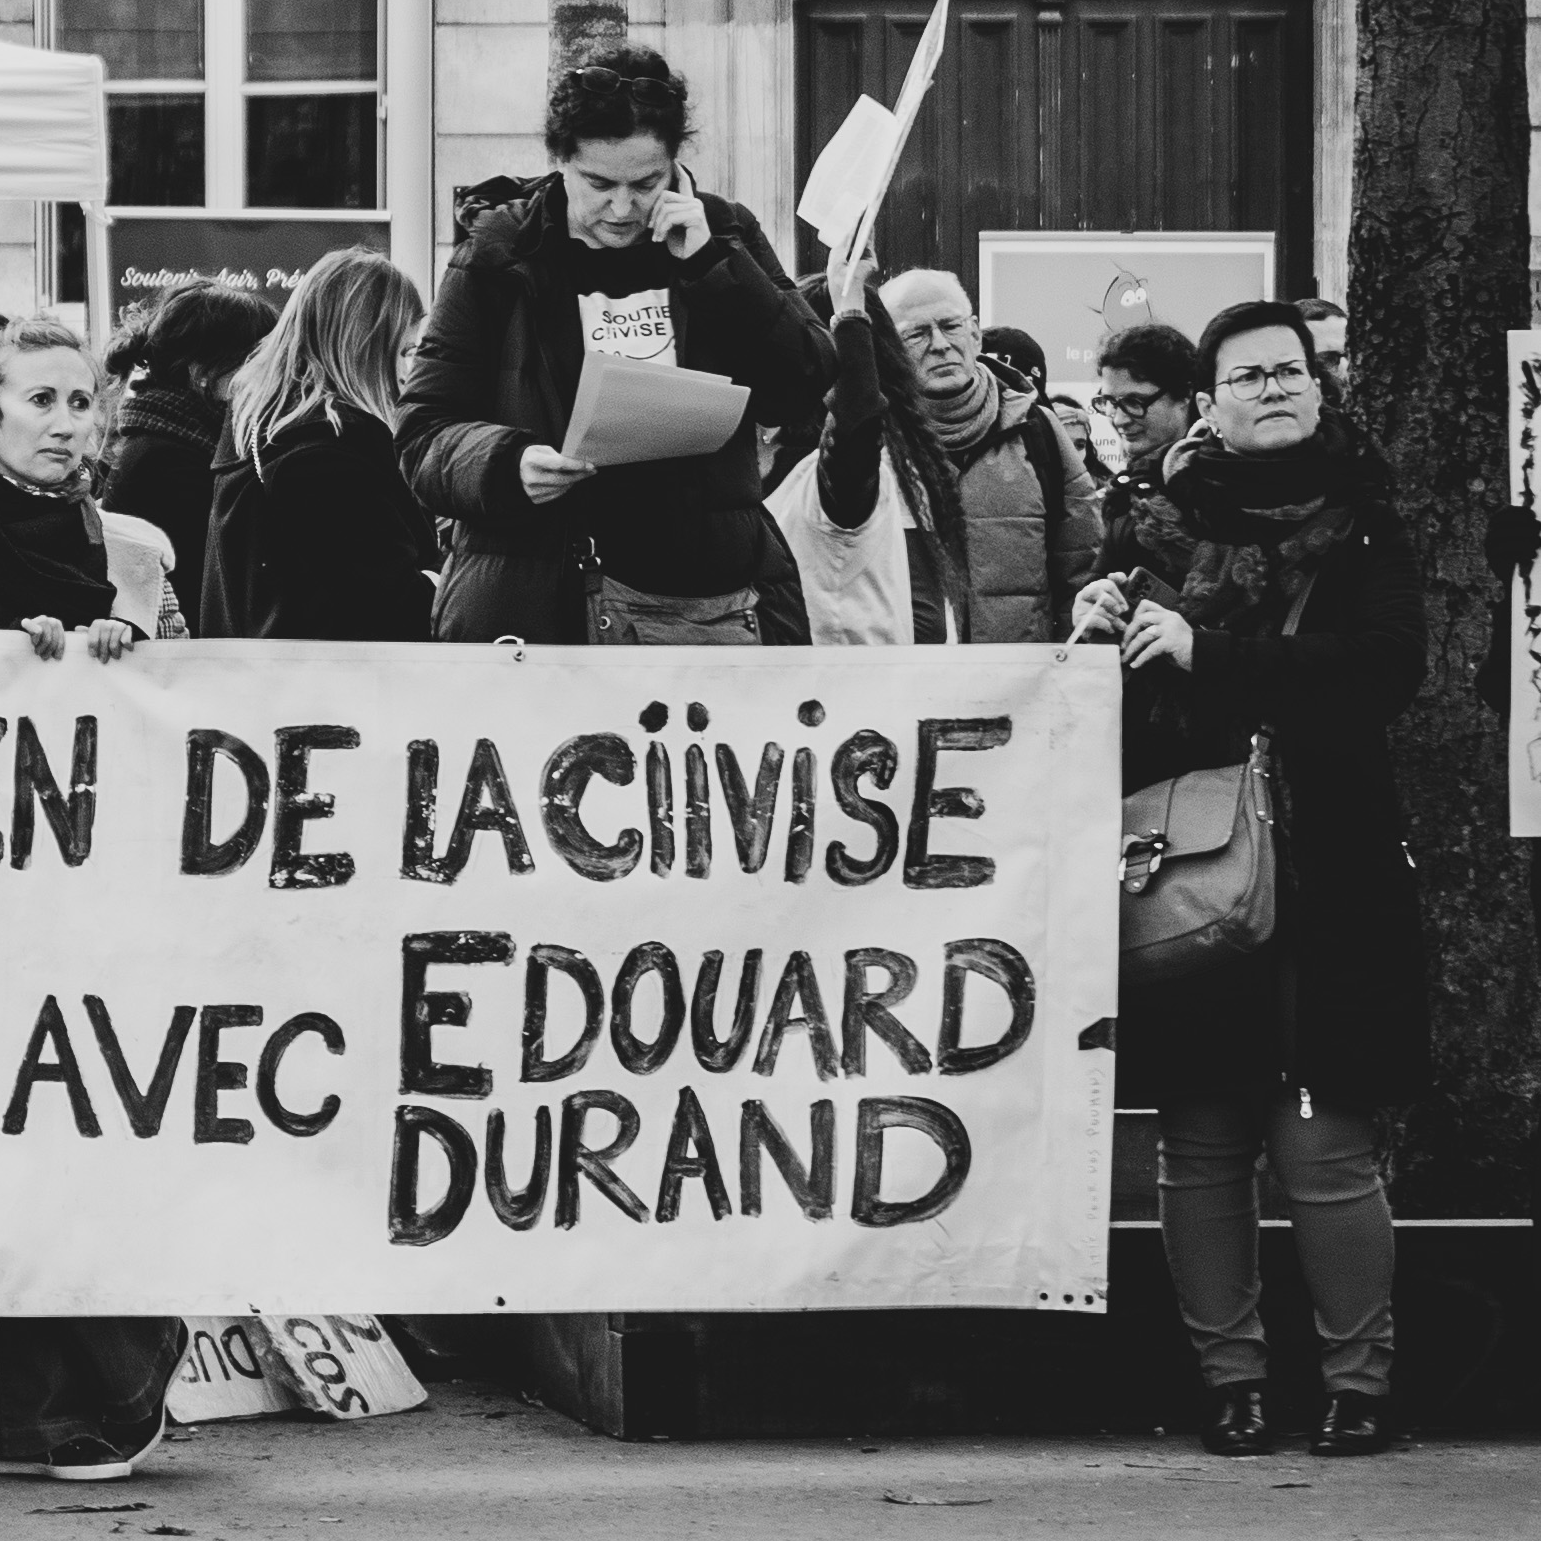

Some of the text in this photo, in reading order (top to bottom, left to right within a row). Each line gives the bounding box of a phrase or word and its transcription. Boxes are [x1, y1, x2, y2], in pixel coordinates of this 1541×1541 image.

[178, 725, 361, 889] DE
[1, 929, 1037, 1146] AVEC EDOUARD
[387, 1084, 972, 1248] DURAND
